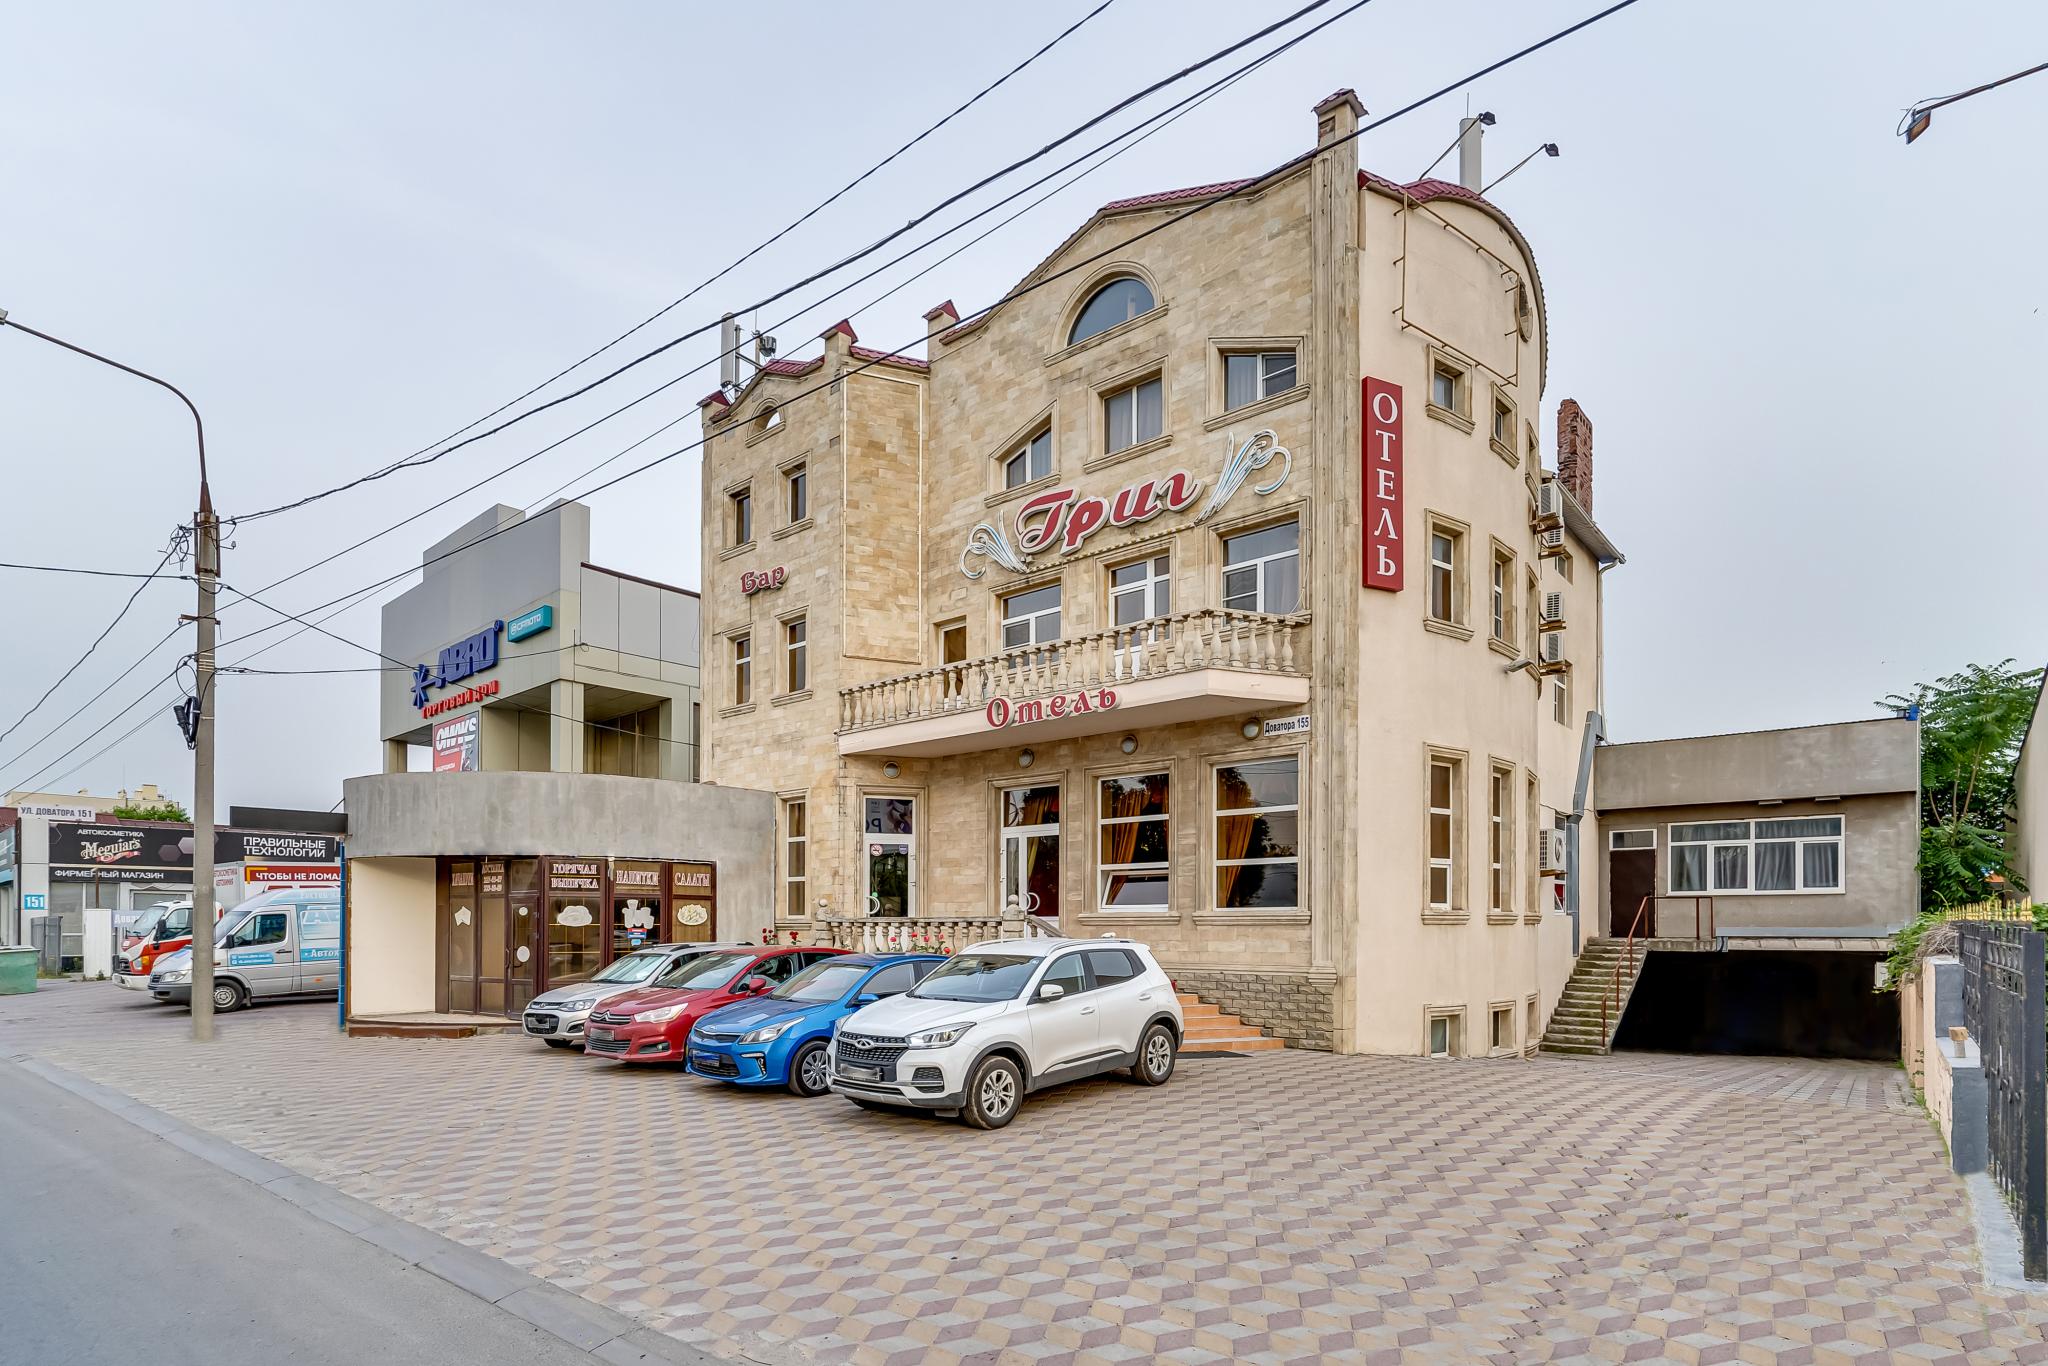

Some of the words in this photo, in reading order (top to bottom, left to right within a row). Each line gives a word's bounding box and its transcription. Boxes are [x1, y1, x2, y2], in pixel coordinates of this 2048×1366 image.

[1372, 392, 1399, 577] ОТЕЛЬ
[1015, 470, 1201, 551] Григ
[740, 565, 787, 594] Бар
[421, 687, 473, 719] ТОРГОВЫЙ
[472, 679, 500, 703] ДОМ
[985, 686, 1119, 728] Отель
[1264, 720, 1296, 735] Доватора
[1297, 716, 1310, 729] 155
[20, 806, 34, 815] УЛ.
[36, 807, 75, 817] ДОВАТОРА
[77, 808, 92, 818] 151
[77, 828, 145, 838] АВТОКОСМЕТИКА
[80, 838, 142, 862] Meguiar's
[243, 836, 327, 850] ПРАВИЛЬНЫЕ
[244, 845, 326, 858] ТЕХНОЛОГИИ
[121, 871, 164, 880] МАГАЗИН
[552, 863, 598, 875] ГОРЯЧАЯ
[255, 872, 292, 881] ЧТОБЫ
[294, 872, 307, 881] НЕ
[550, 878, 600, 889] ВЫПЕЧКА
[615, 870, 660, 886] НАПИТКИ
[674, 872, 711, 887] САЛАТЫ
[25, 895, 45, 909] 151
